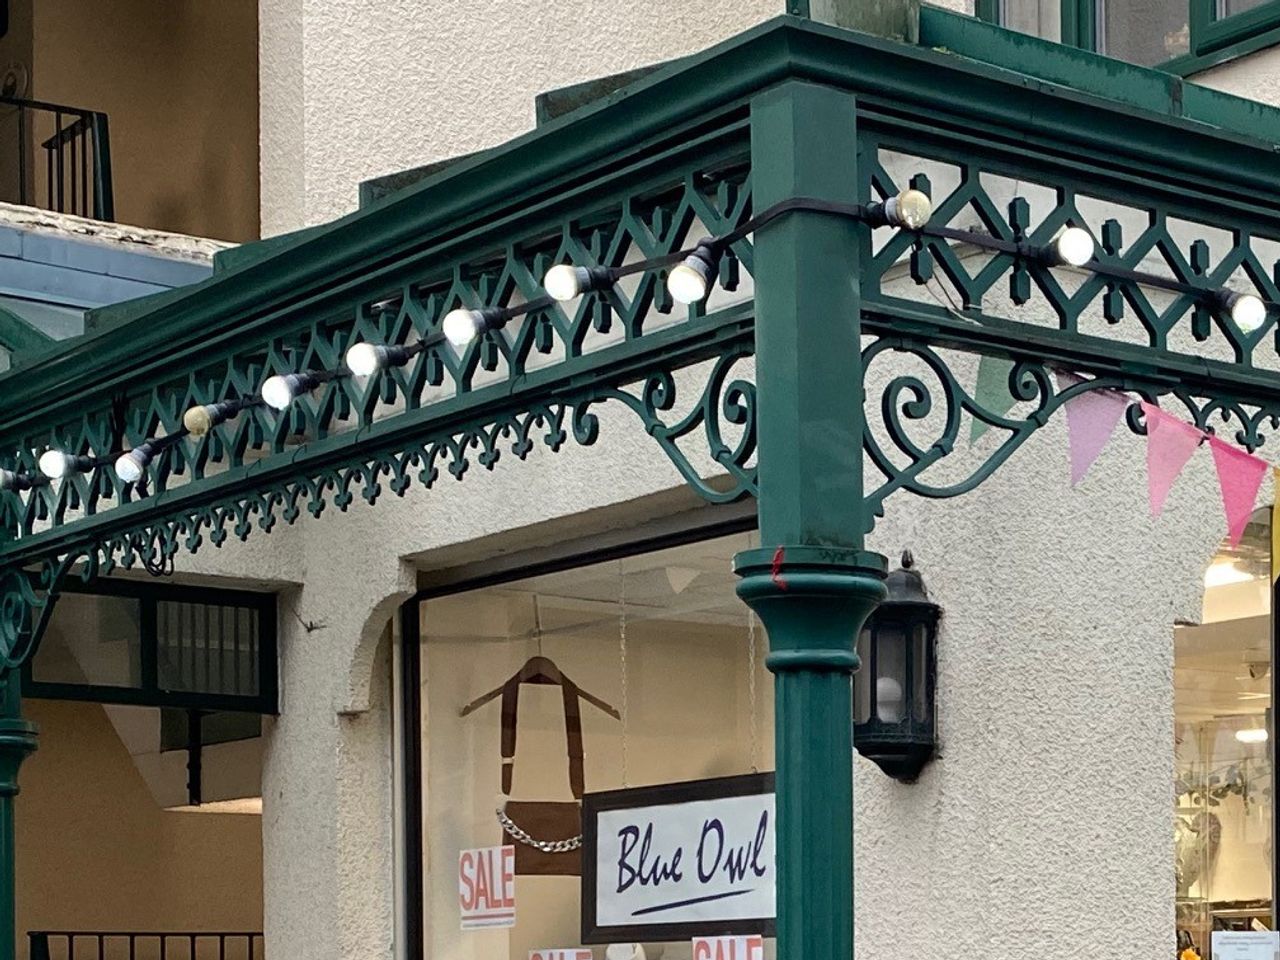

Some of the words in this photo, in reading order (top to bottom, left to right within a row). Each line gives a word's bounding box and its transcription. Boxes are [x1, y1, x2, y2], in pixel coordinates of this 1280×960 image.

[459, 847, 515, 911] SALE
[616, 822, 684, 893] Blue
[697, 810, 769, 884] Owl
